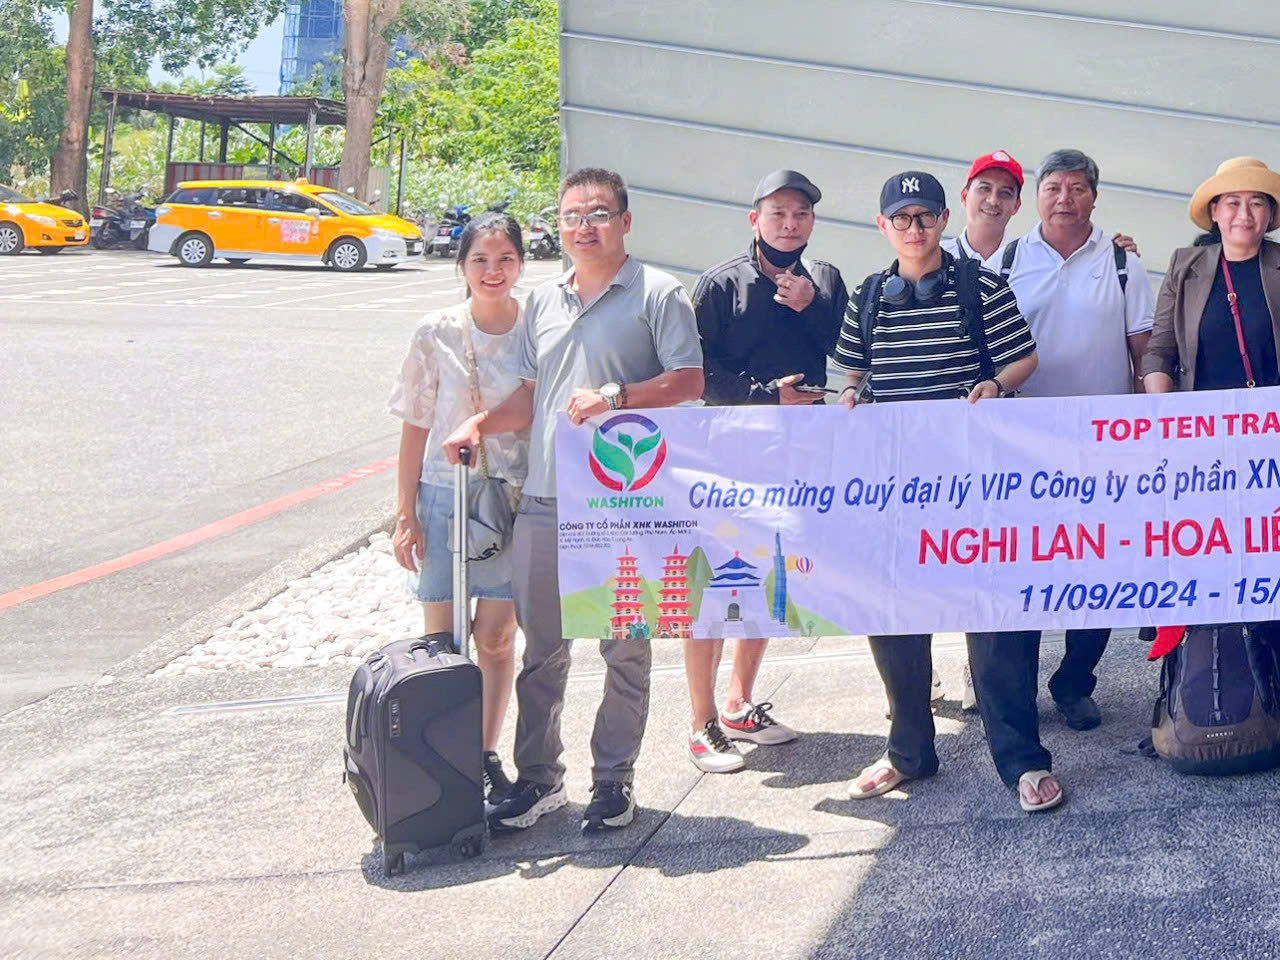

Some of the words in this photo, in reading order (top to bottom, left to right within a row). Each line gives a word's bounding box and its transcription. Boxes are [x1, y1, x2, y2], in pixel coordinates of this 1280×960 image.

[1091, 418, 1152, 442] TOP
[1157, 415, 1215, 439] TEN
[688, 480, 755, 509] Chào
[762, 479, 835, 514] mừng
[844, 475, 895, 512] Quý
[901, 475, 942, 510] đại
[948, 473, 972, 510] lý
[981, 472, 1022, 501] VIP
[1030, 469, 1097, 504] Công
[1105, 470, 1129, 503] ty
[1136, 458, 1168, 495] cổ
[1173, 459, 1237, 501] phần
[587, 496, 665, 510] WASHITON
[633, 521, 651, 529] XNK
[654, 520, 698, 529] WASHITON
[918, 526, 1018, 565] NGHI
[1031, 523, 1105, 561] LAN
[1144, 517, 1233, 557] HOA
[1020, 579, 1198, 612] 11/09/2024
